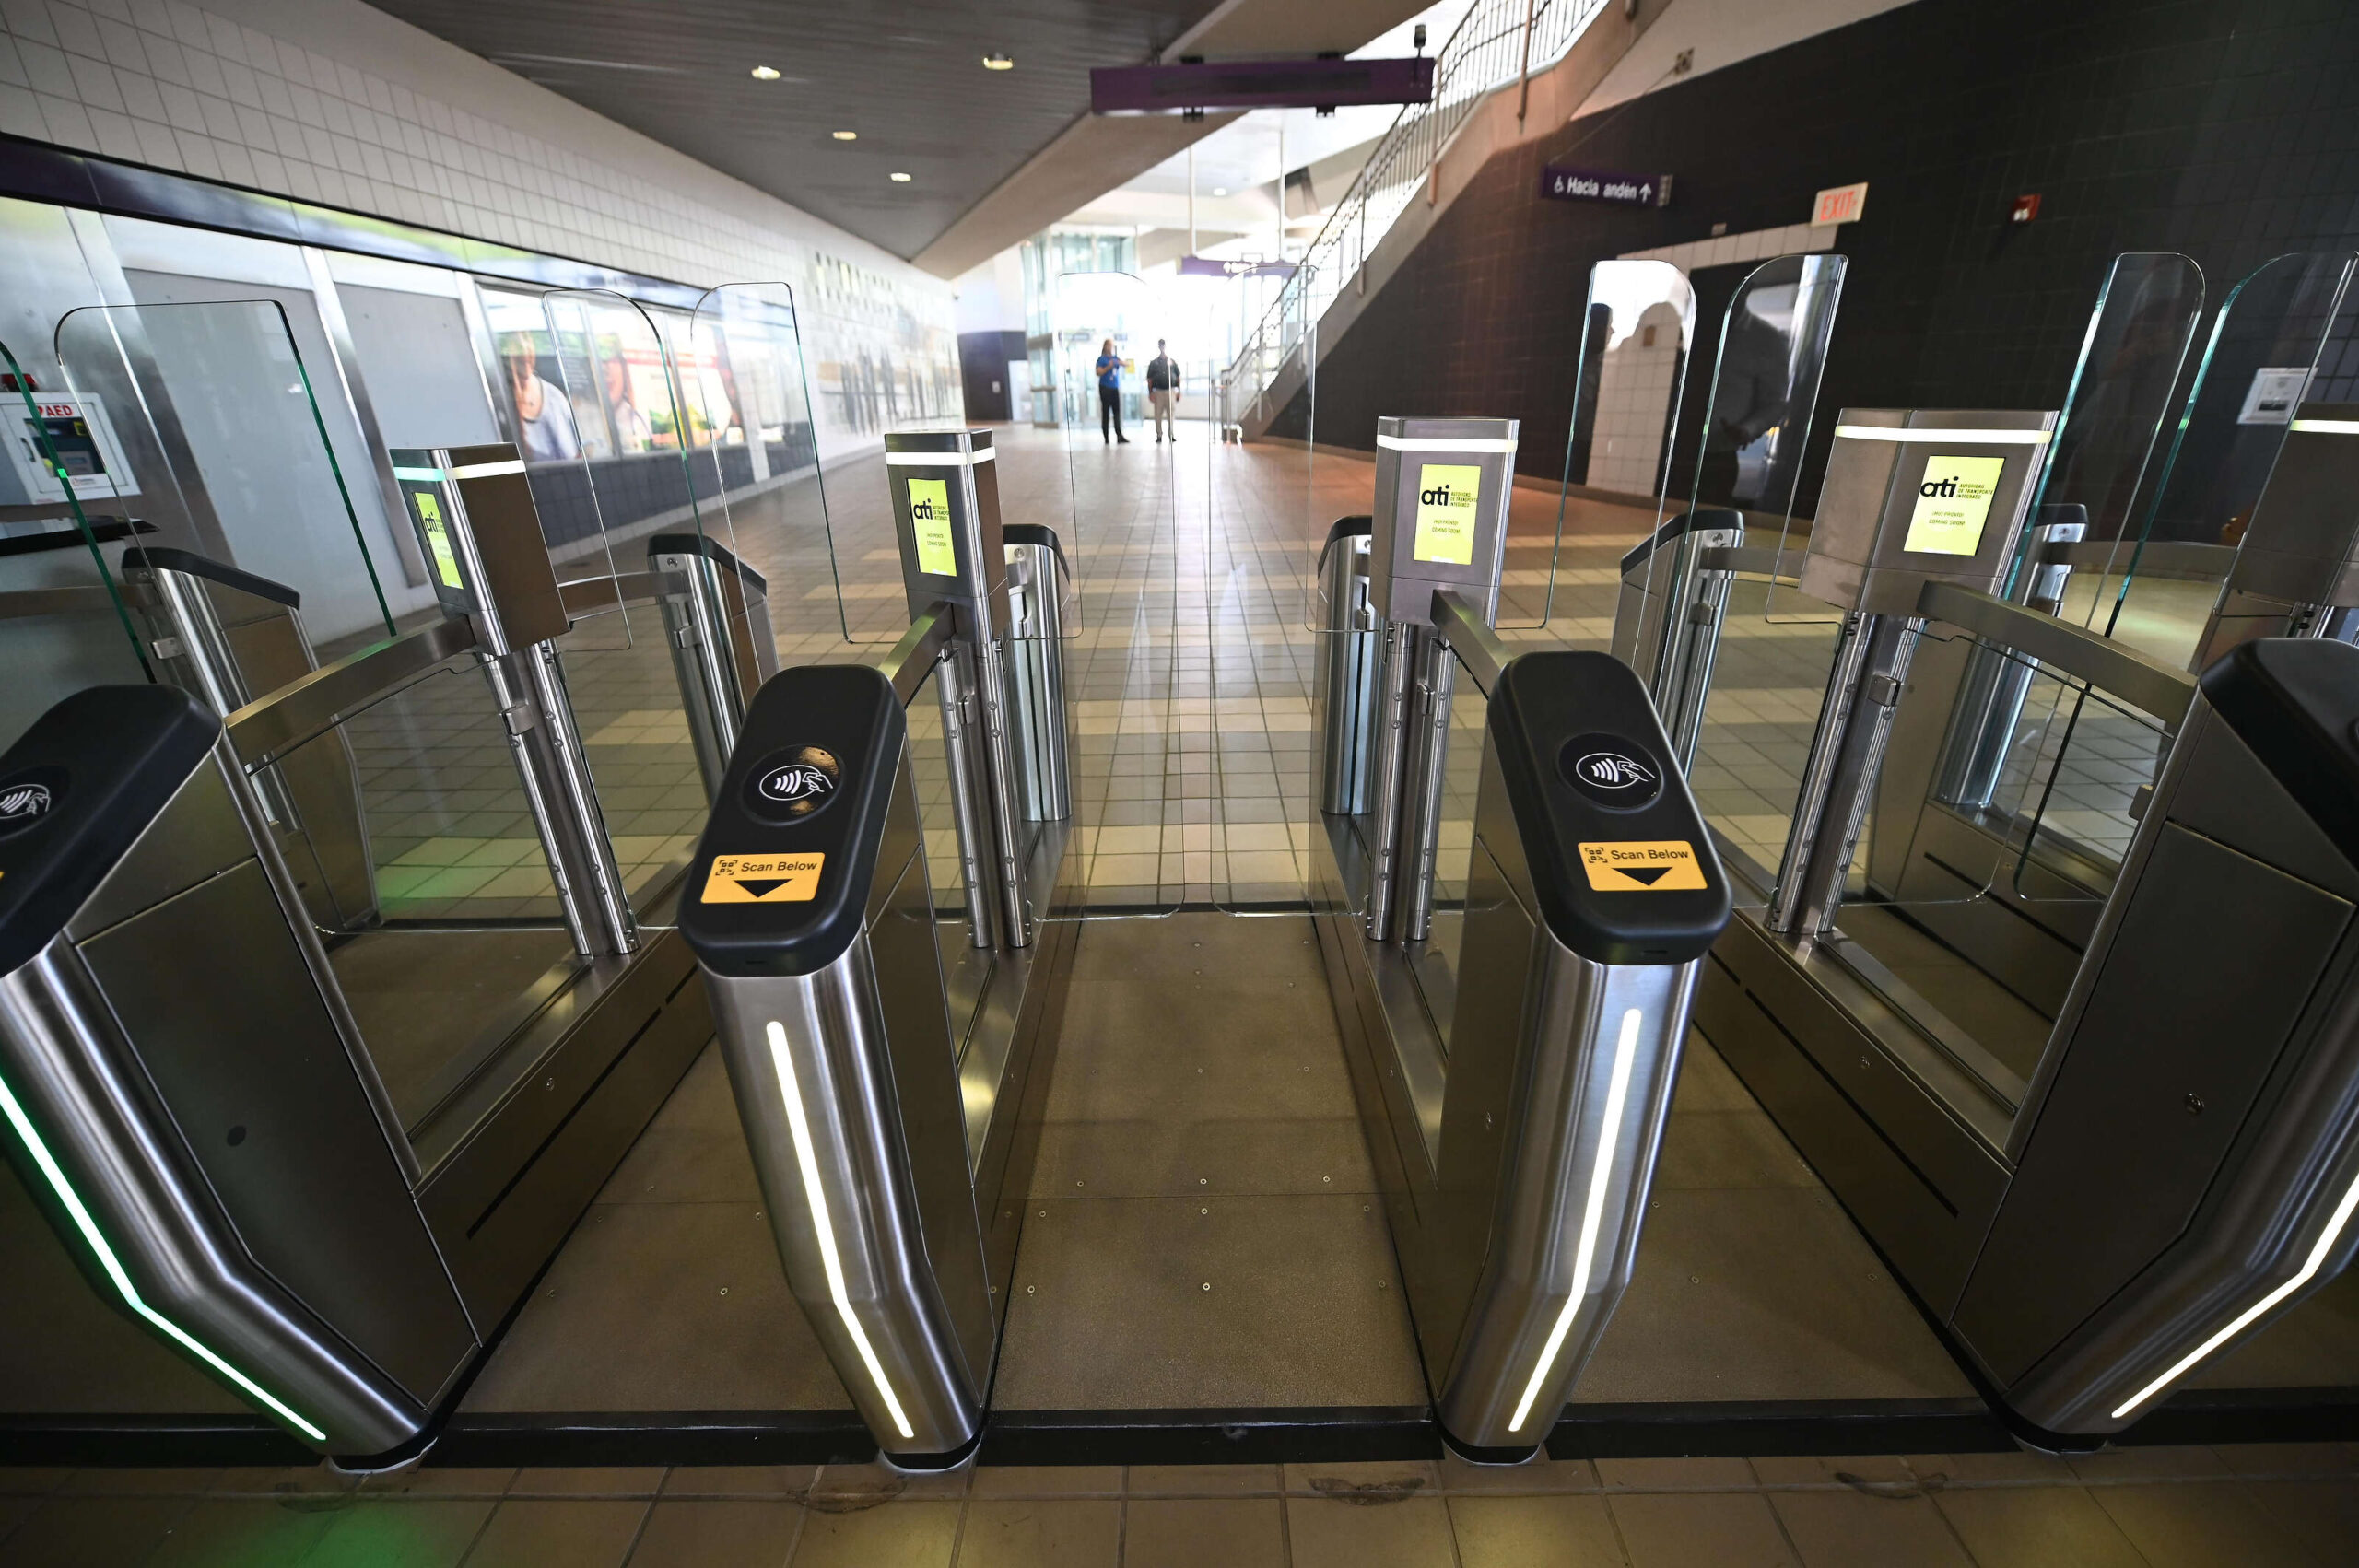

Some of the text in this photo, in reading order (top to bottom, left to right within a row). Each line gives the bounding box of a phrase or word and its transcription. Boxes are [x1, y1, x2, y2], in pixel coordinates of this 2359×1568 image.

[1567, 176, 1637, 200] Hacia andén
[1820, 191, 1855, 221] EXIT
[46, 405, 73, 416] AED
[1421, 485, 1449, 506] ati
[1920, 475, 1959, 497] ati
[913, 498, 933, 520] ati
[1611, 849, 1689, 860] Scan Below
[741, 861, 817, 872] Scan Below
